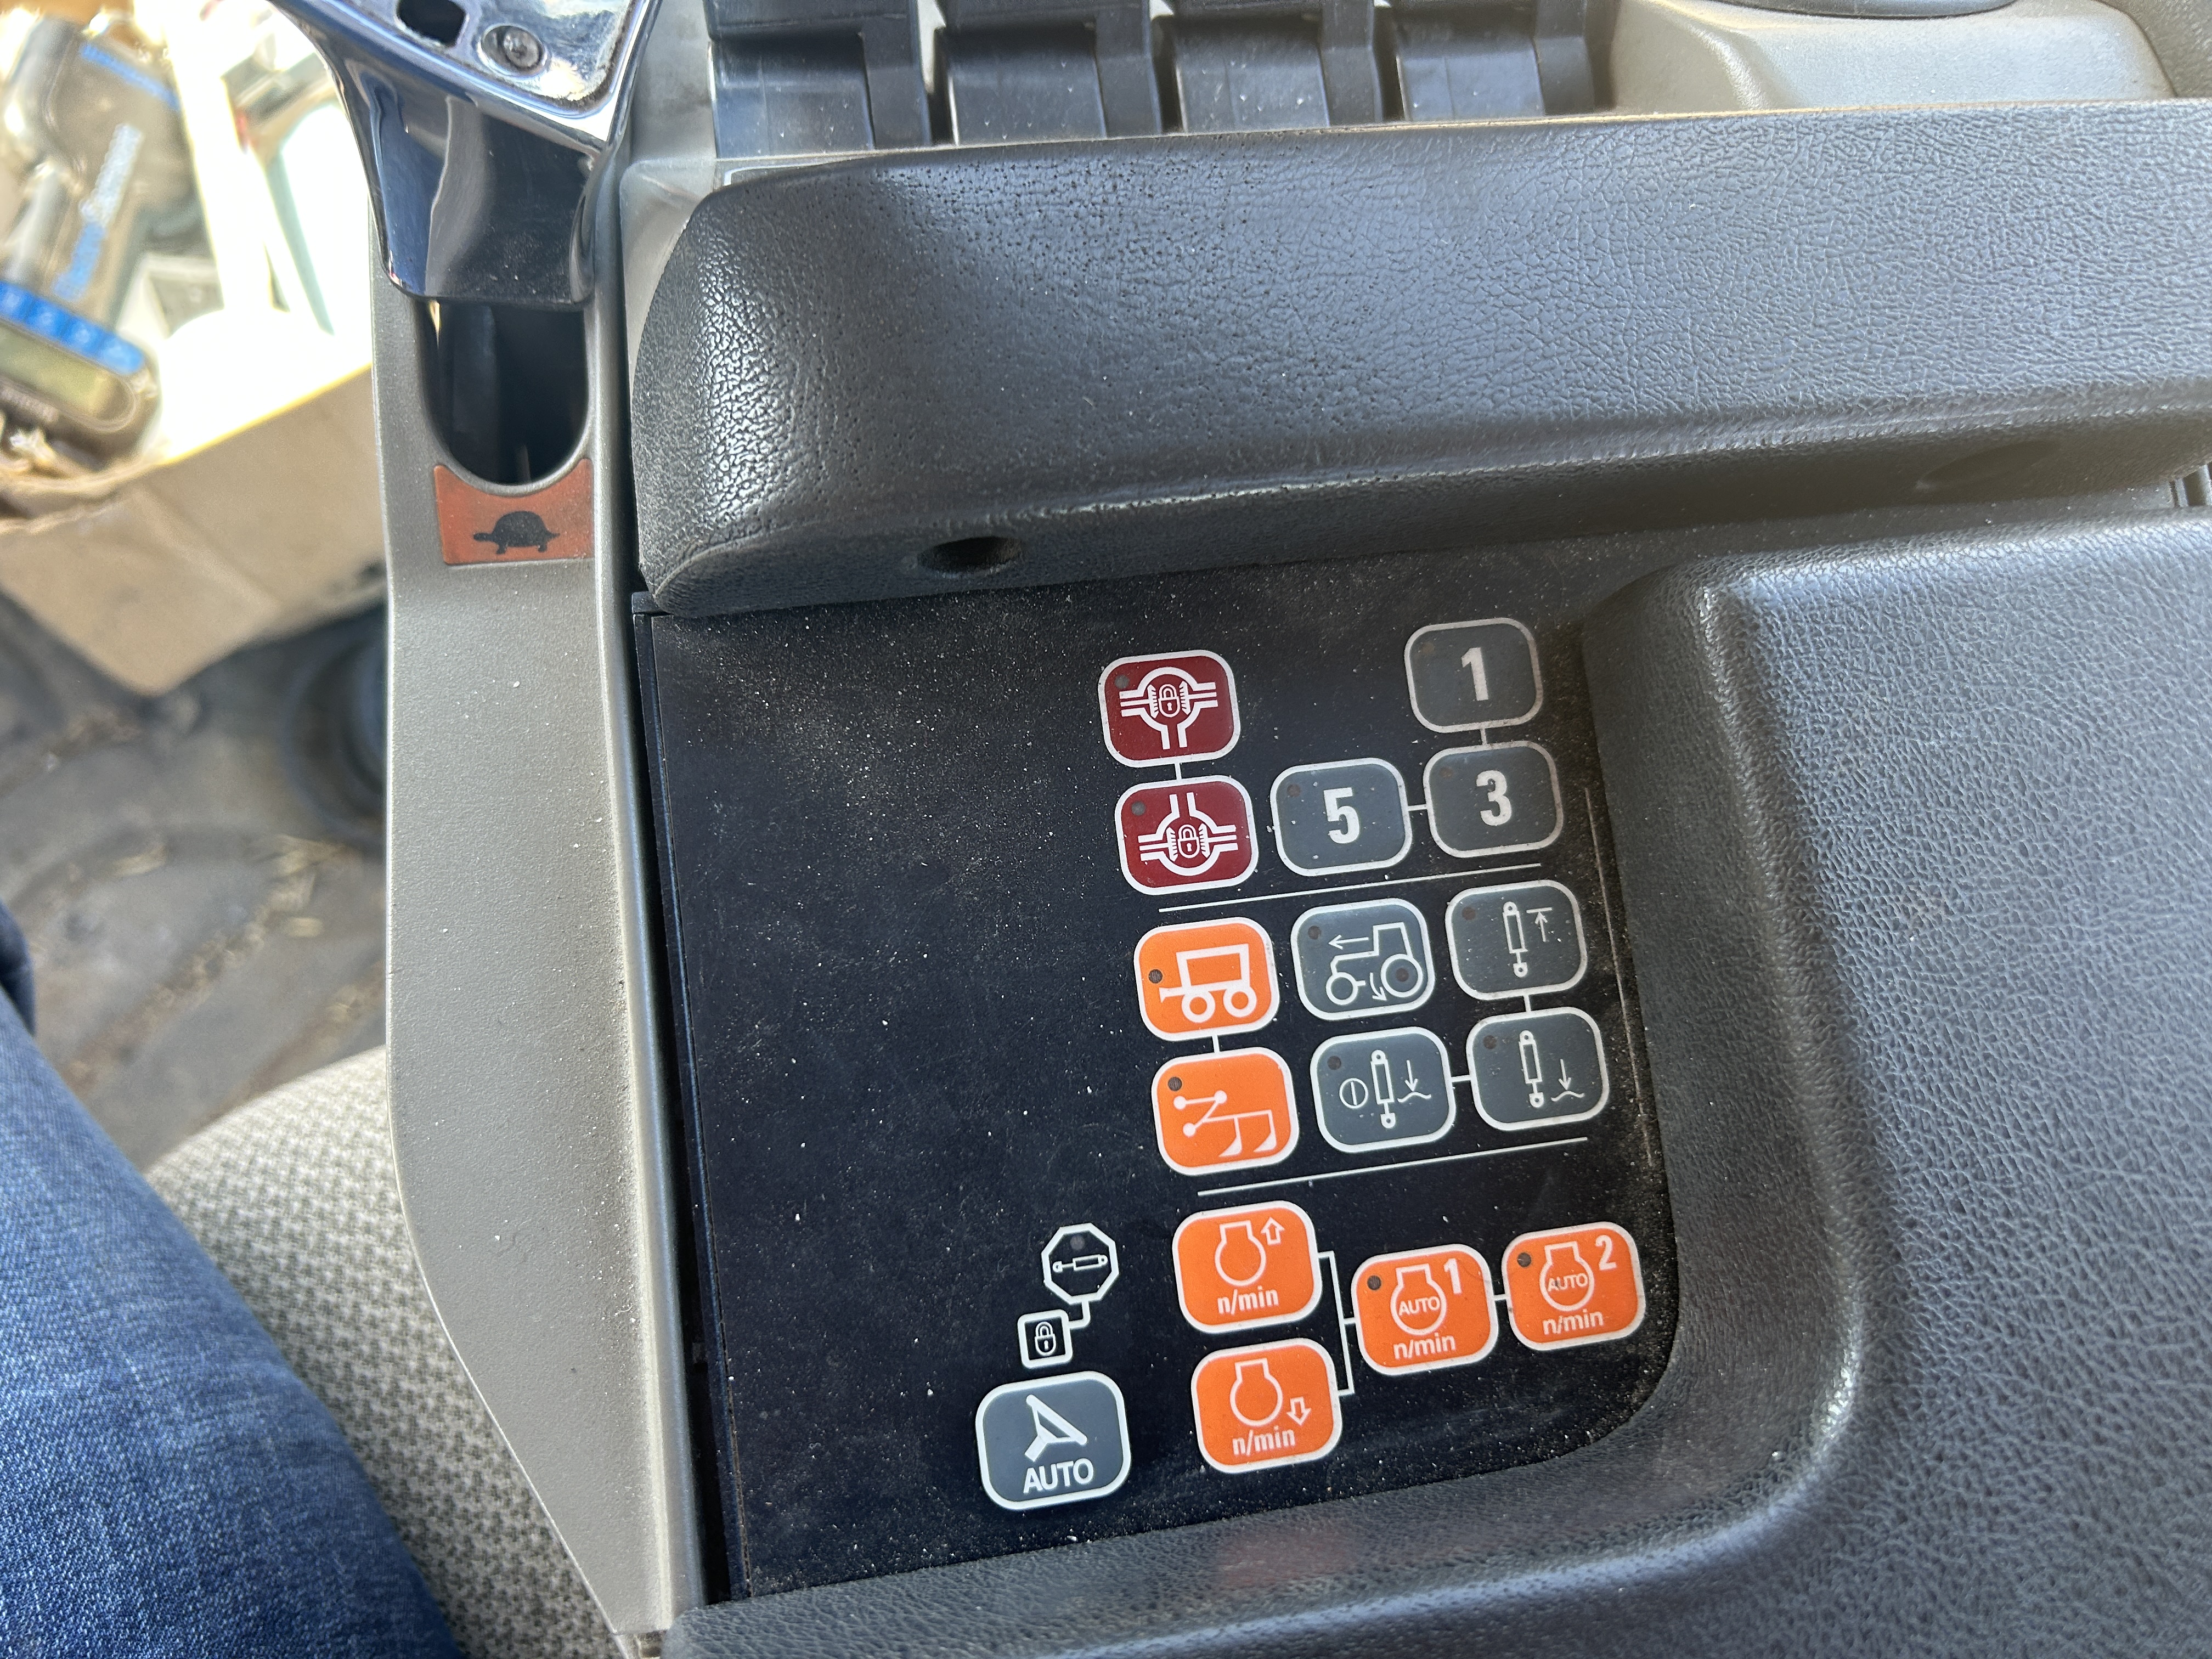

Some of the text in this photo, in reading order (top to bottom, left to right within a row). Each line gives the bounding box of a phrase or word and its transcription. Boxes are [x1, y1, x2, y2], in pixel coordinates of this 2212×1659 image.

[1461, 647, 1489, 701] 1
[1476, 769, 1513, 826] 3
[1323, 787, 1361, 844] 5
[1595, 1235, 1617, 1271] 2
[1443, 1258, 1463, 1295] 1
[1547, 1273, 1588, 1292] AUTO
[1217, 1285, 1279, 1315] n/min
[1399, 1296, 1440, 1316] AUTO
[1542, 1309, 1604, 1335] n/min
[1393, 1333, 1456, 1360] n/min
[1232, 1425, 1295, 1457] n/min
[1023, 1458, 1094, 1494] AUTO
